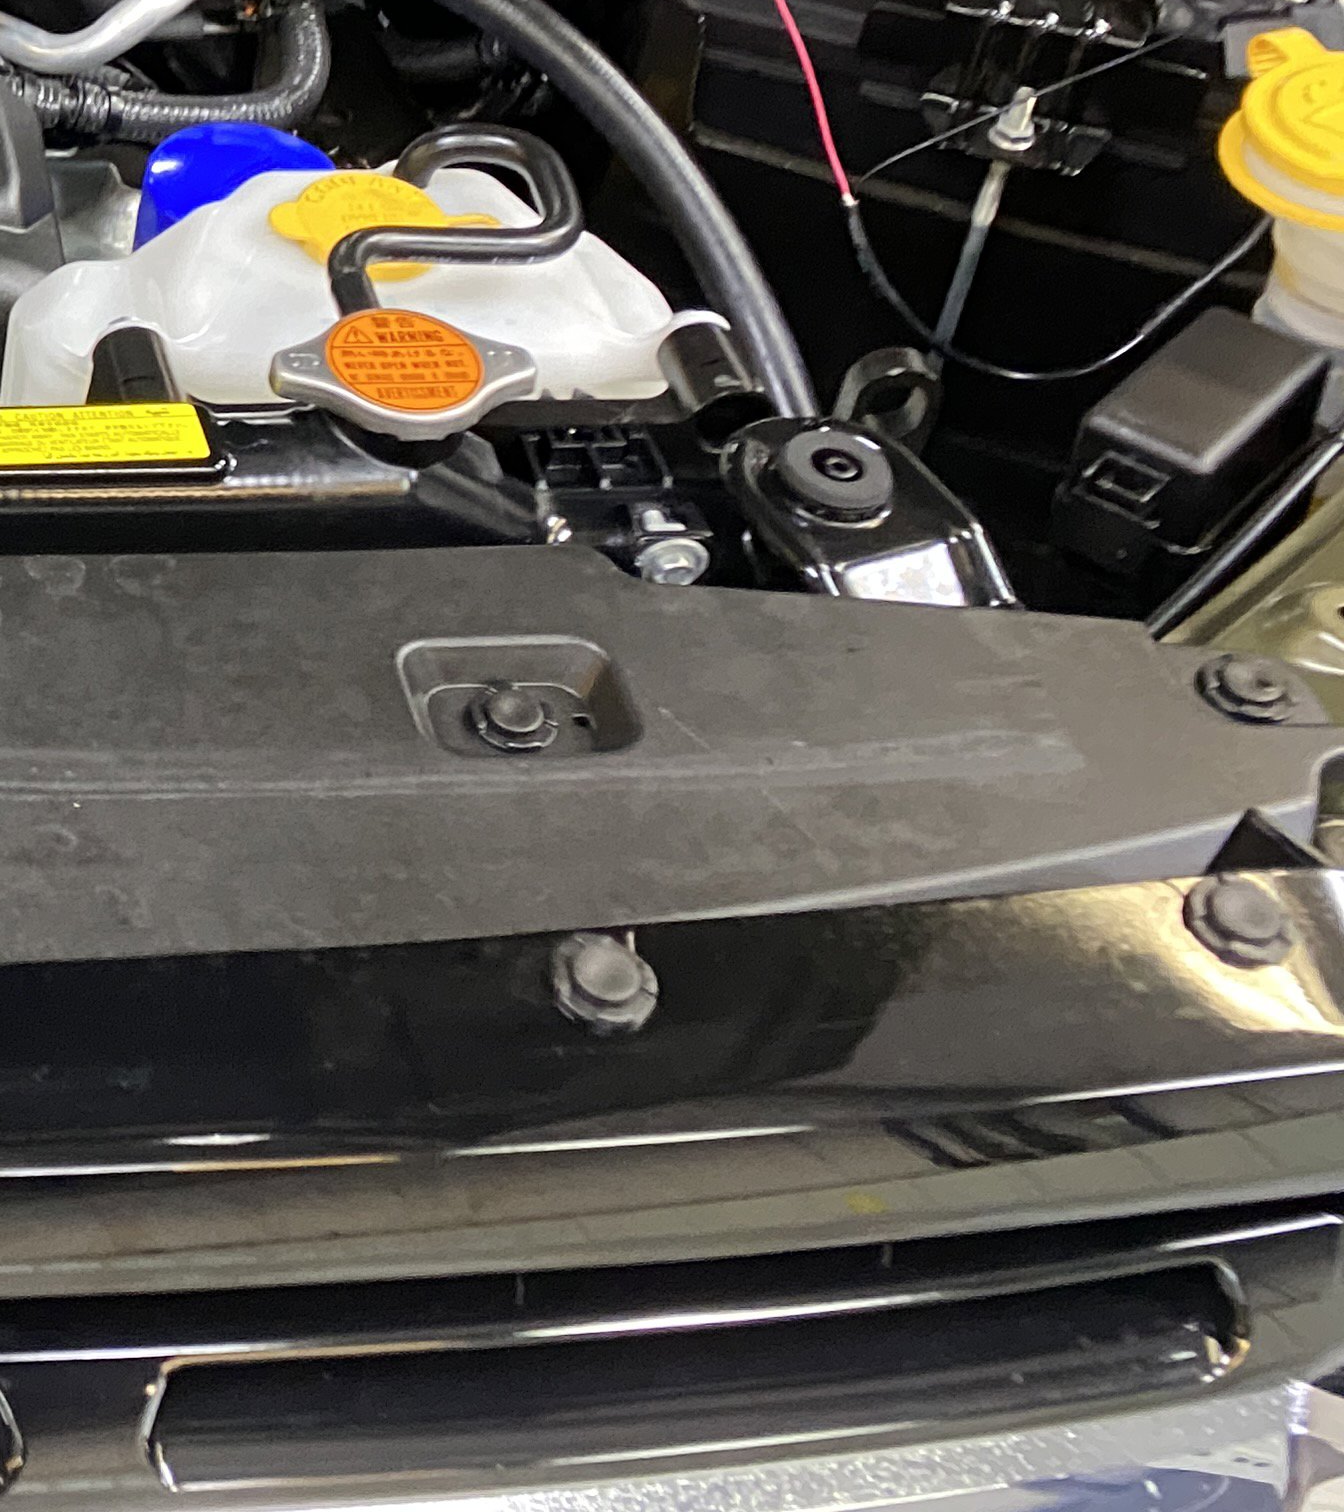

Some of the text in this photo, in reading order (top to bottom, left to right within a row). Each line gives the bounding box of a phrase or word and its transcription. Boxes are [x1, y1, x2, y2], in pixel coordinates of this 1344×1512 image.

[375, 330, 445, 344] WARNING
[379, 361, 408, 370] OPEN
[15, 412, 65, 423] CAUTION
[72, 410, 134, 422] ATTENTION
